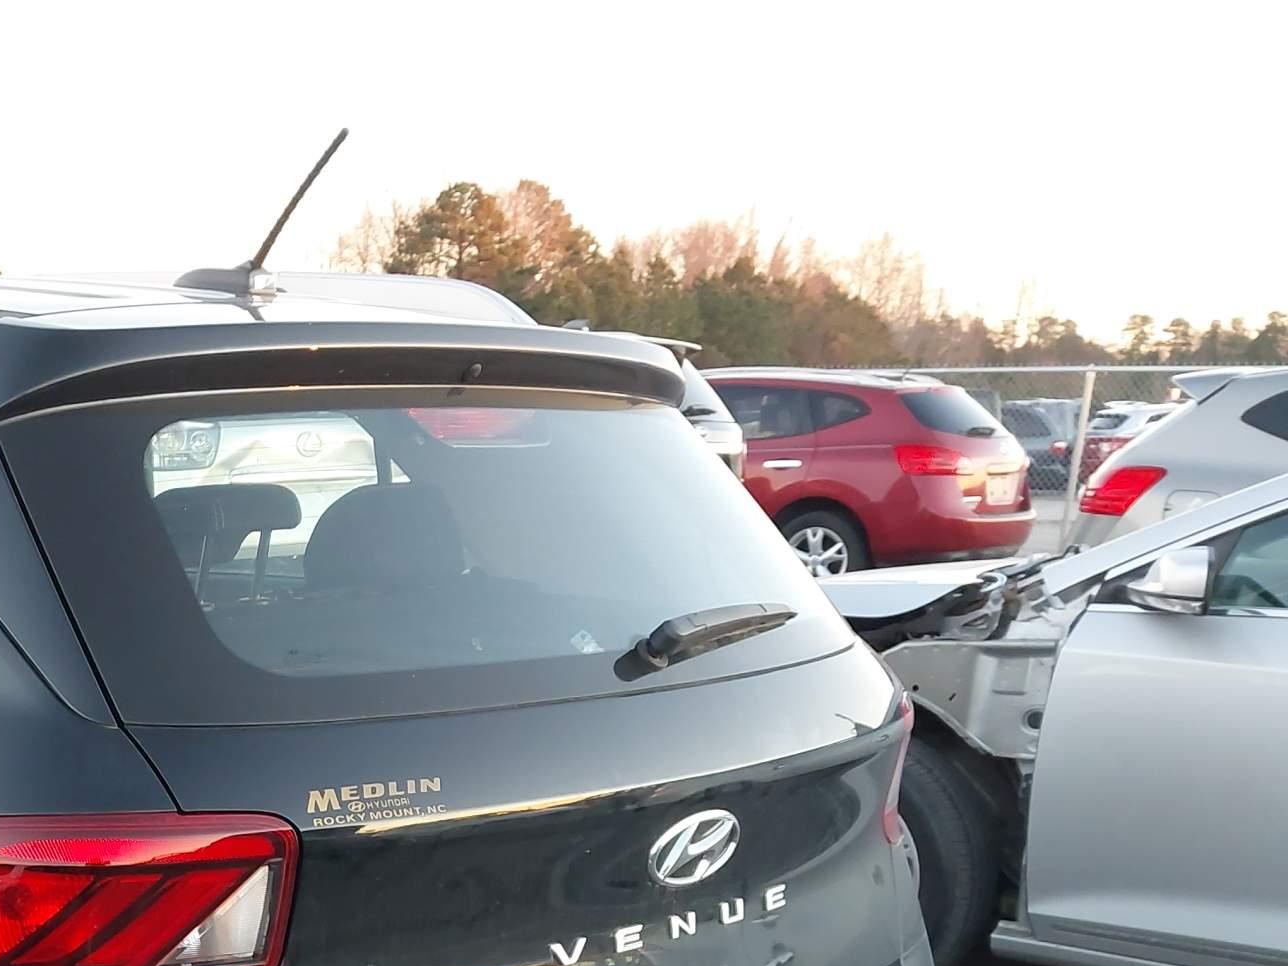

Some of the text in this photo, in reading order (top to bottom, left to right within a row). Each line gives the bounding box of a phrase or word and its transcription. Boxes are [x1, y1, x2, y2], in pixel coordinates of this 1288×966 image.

[307, 777, 441, 814] MEDLIN
[313, 804, 448, 828] ROCKY MOUNT, NC
[549, 883, 788, 966] VENUE
